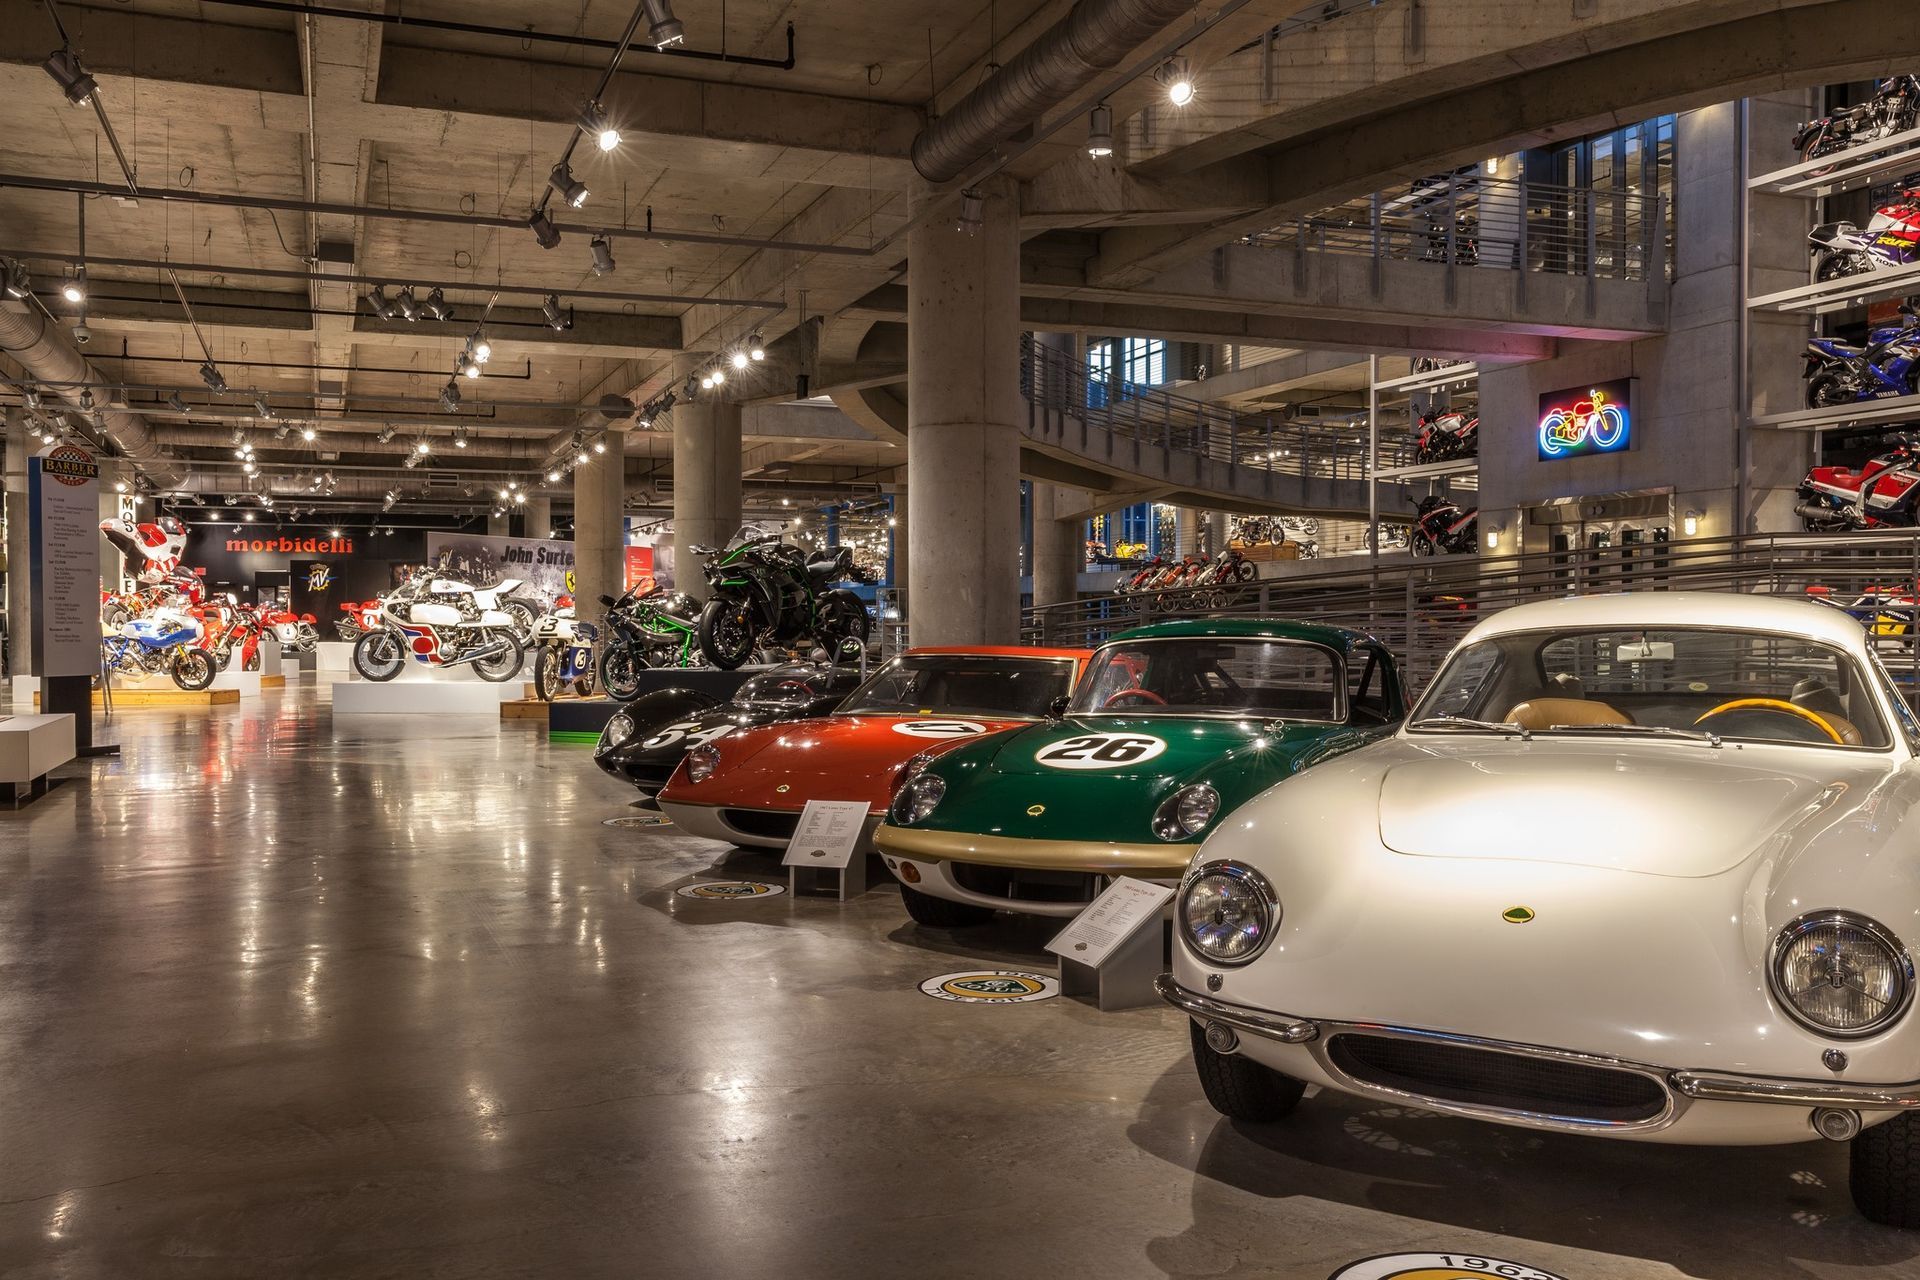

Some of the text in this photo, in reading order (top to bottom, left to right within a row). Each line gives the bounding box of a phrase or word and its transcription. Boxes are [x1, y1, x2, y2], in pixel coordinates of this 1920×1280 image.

[1876, 390, 1900, 399] YAMAHA
[45, 459, 96, 476] BARBER
[226, 536, 353, 553] morbidelli
[500, 545, 576, 566] John Surte
[308, 567, 330, 592] MV
[642, 721, 738, 750] 54
[1041, 736, 1156, 762] 26
